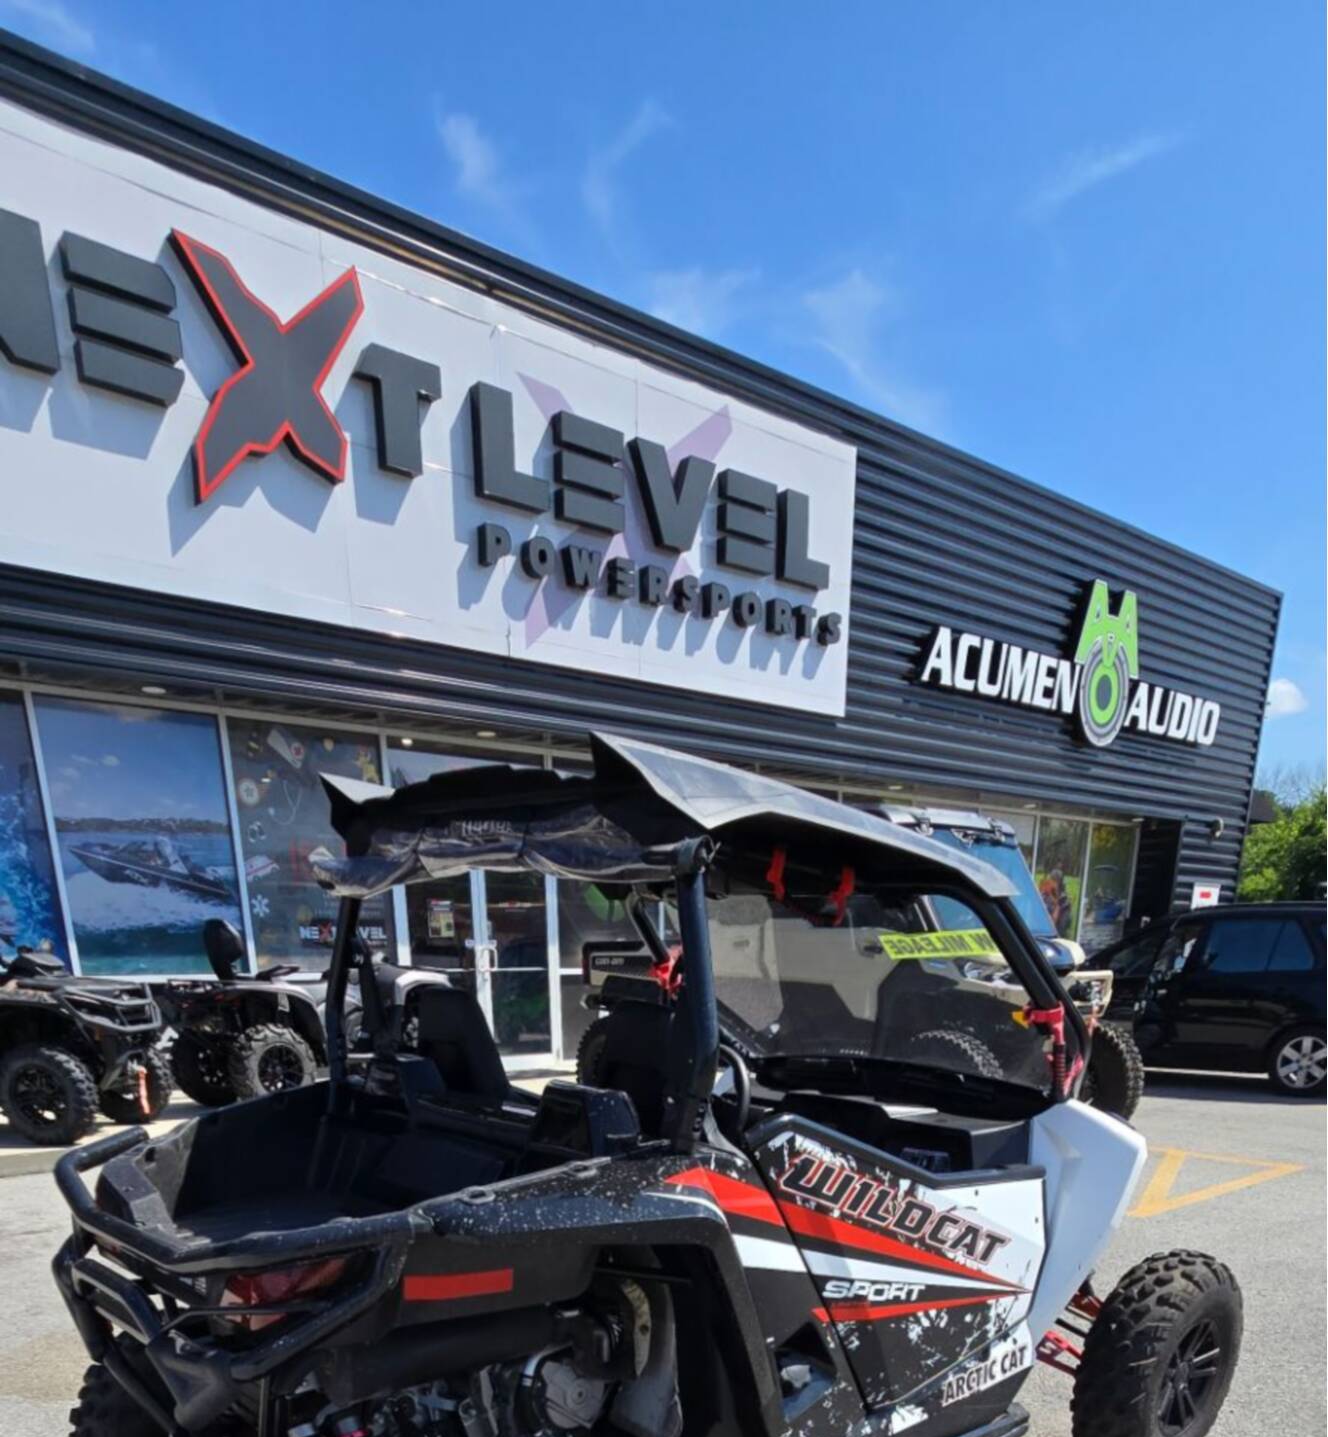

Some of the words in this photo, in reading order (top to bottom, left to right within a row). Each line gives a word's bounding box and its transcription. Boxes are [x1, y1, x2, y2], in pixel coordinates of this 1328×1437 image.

[469, 381, 831, 591] LEVEL
[477, 522, 842, 646] POWERSPORTS
[920, 626, 1081, 715] ACUMEN
[1123, 681, 1221, 746] AUDIO
[780, 1155, 1011, 1264] WILDCAT
[822, 1279, 926, 1301] SPORT
[942, 1361, 997, 1407] ARCTIC
[1000, 1345, 1028, 1375] CAT
